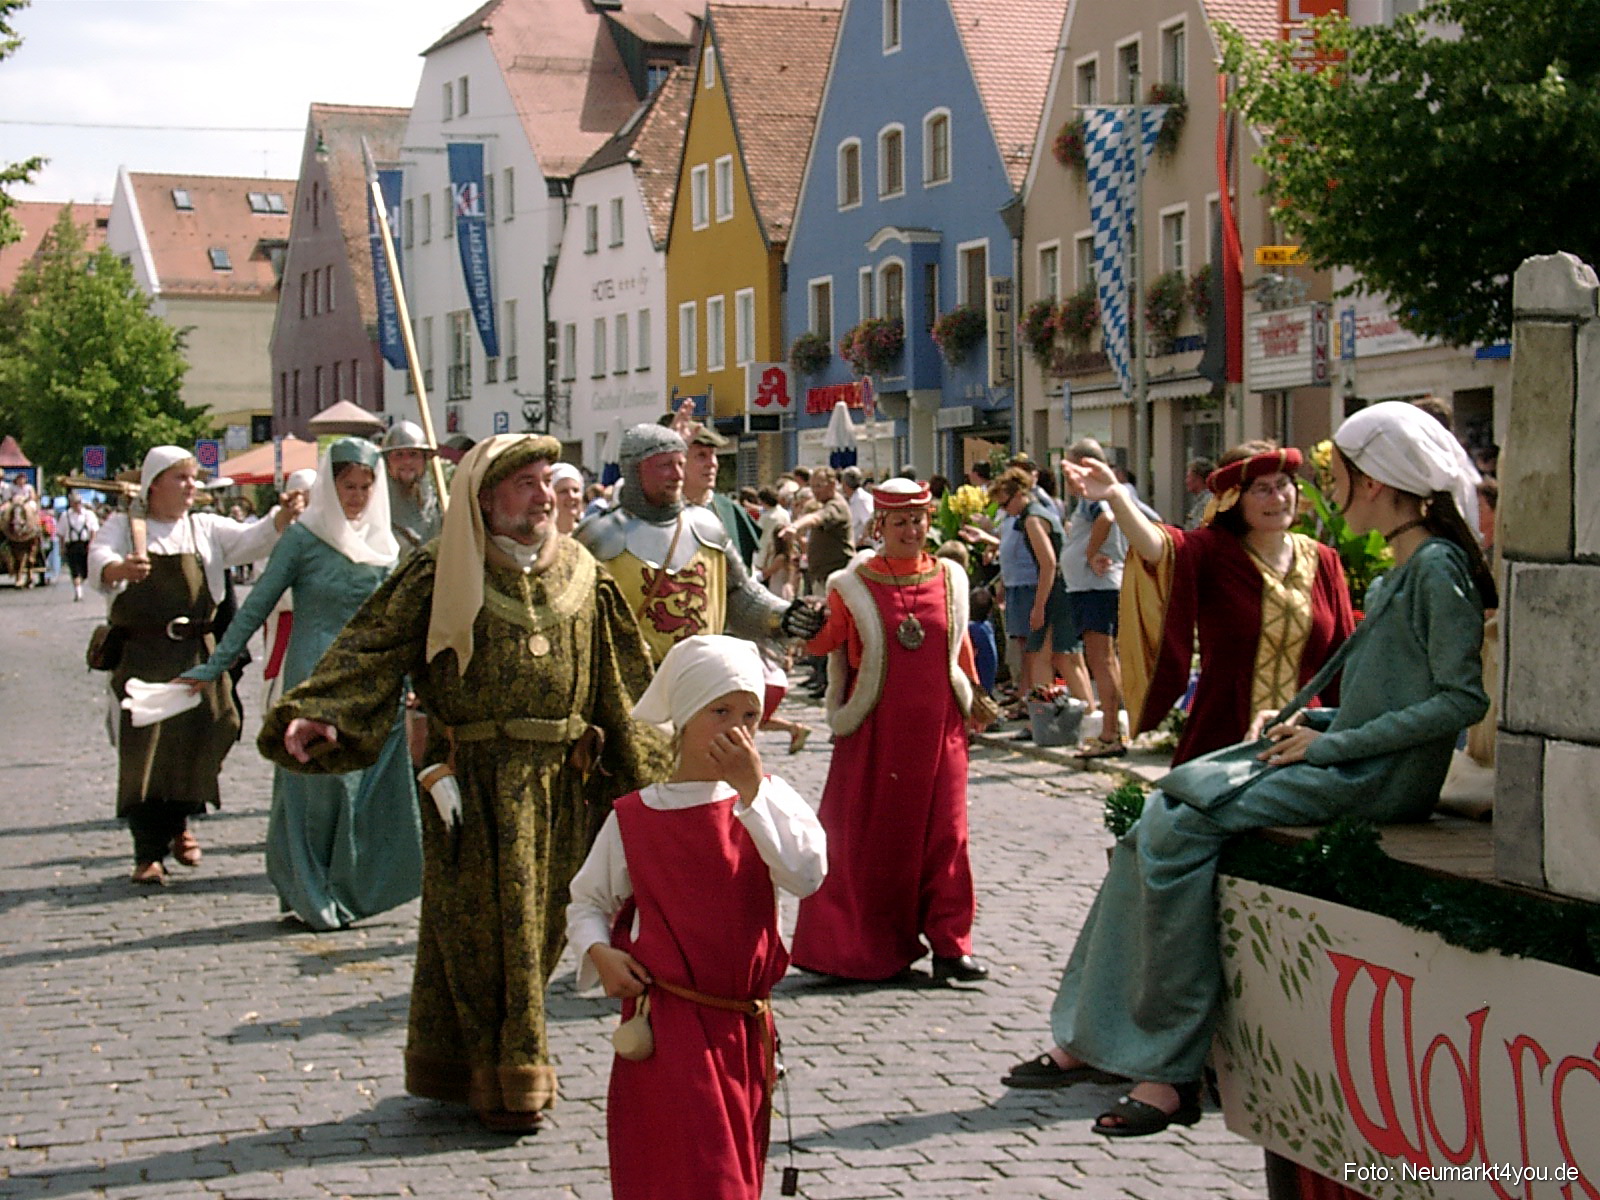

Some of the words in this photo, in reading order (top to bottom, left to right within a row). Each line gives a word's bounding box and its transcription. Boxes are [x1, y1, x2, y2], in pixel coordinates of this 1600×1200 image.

[469, 223, 487, 297] RUPPERT
[592, 279, 615, 301] HOTEL
[1315, 308, 1326, 380] KINO
